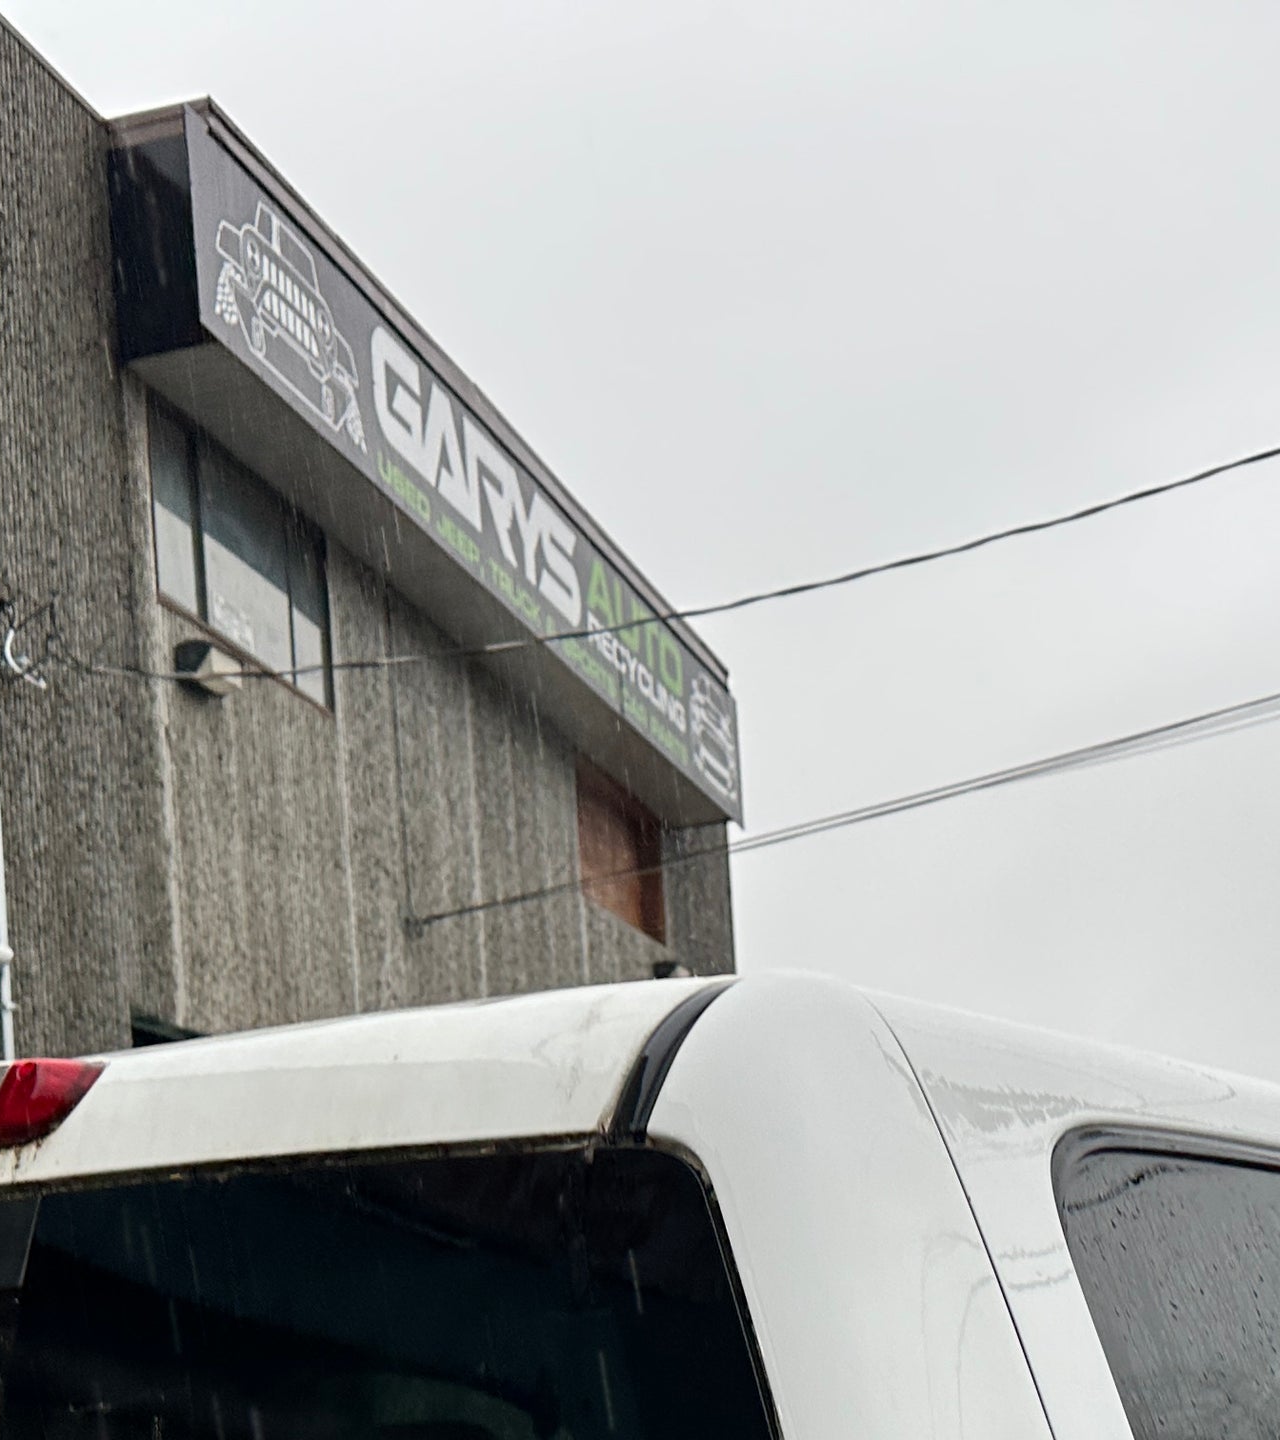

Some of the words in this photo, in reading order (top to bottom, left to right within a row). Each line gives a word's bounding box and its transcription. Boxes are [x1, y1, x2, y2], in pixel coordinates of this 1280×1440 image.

[371, 325, 582, 628] GARYS
[587, 559, 684, 698] AUTO
[587, 610, 687, 735] RECYCLING
